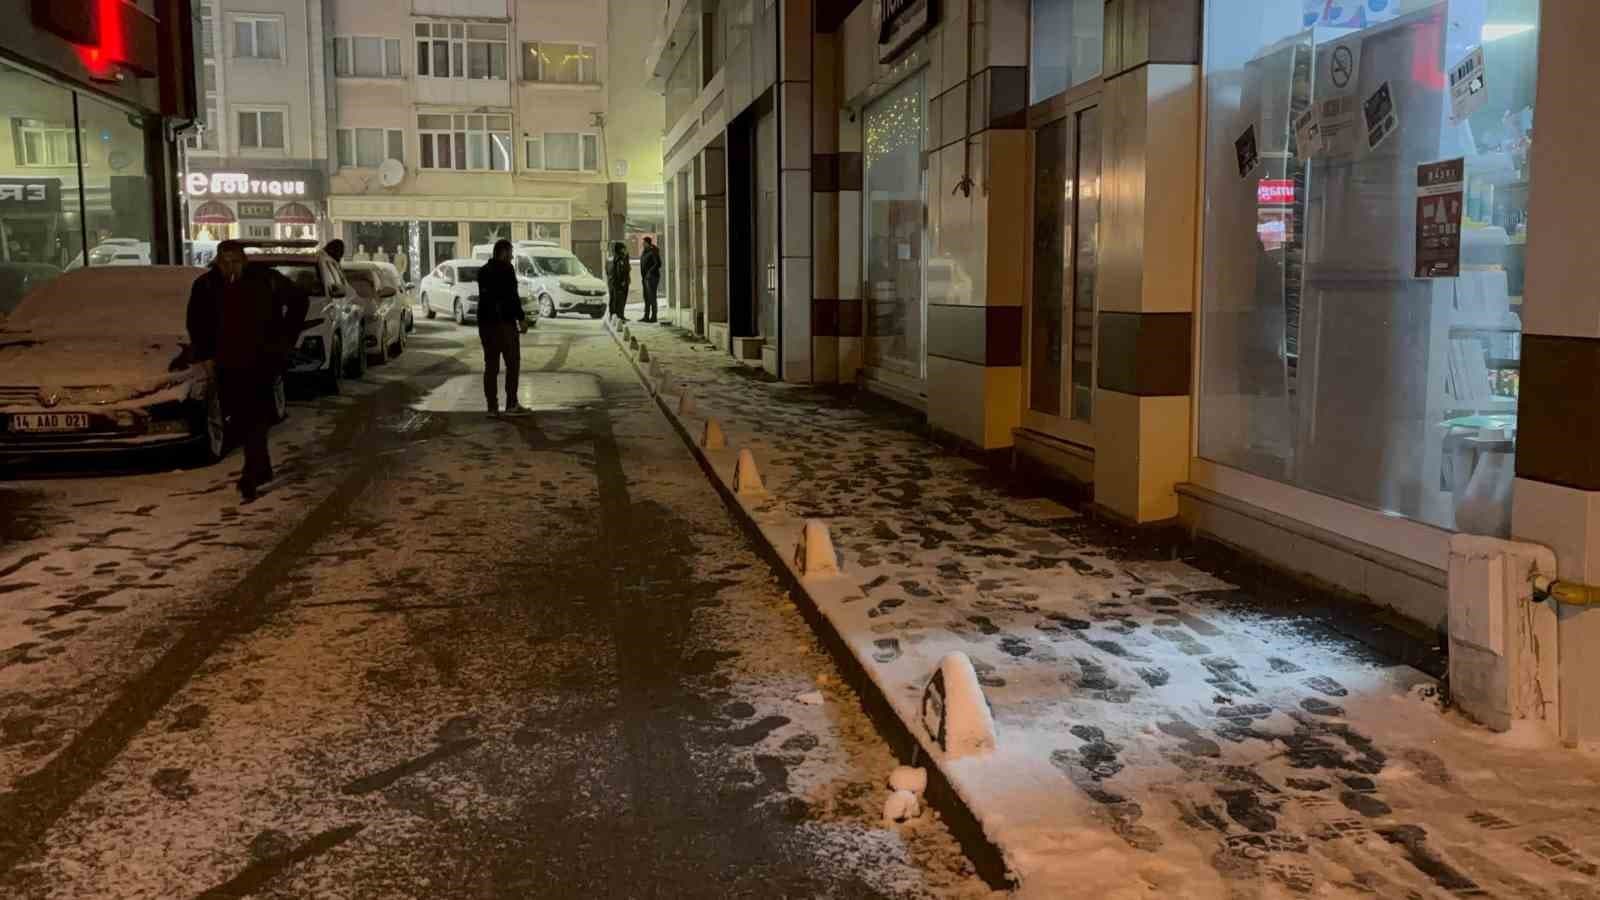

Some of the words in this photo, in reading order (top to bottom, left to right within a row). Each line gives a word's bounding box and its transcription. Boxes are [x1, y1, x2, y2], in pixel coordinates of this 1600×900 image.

[211, 180, 305, 196] BOUTIQUE
[16, 416, 29, 427] 14
[65, 415, 86, 427] 021
